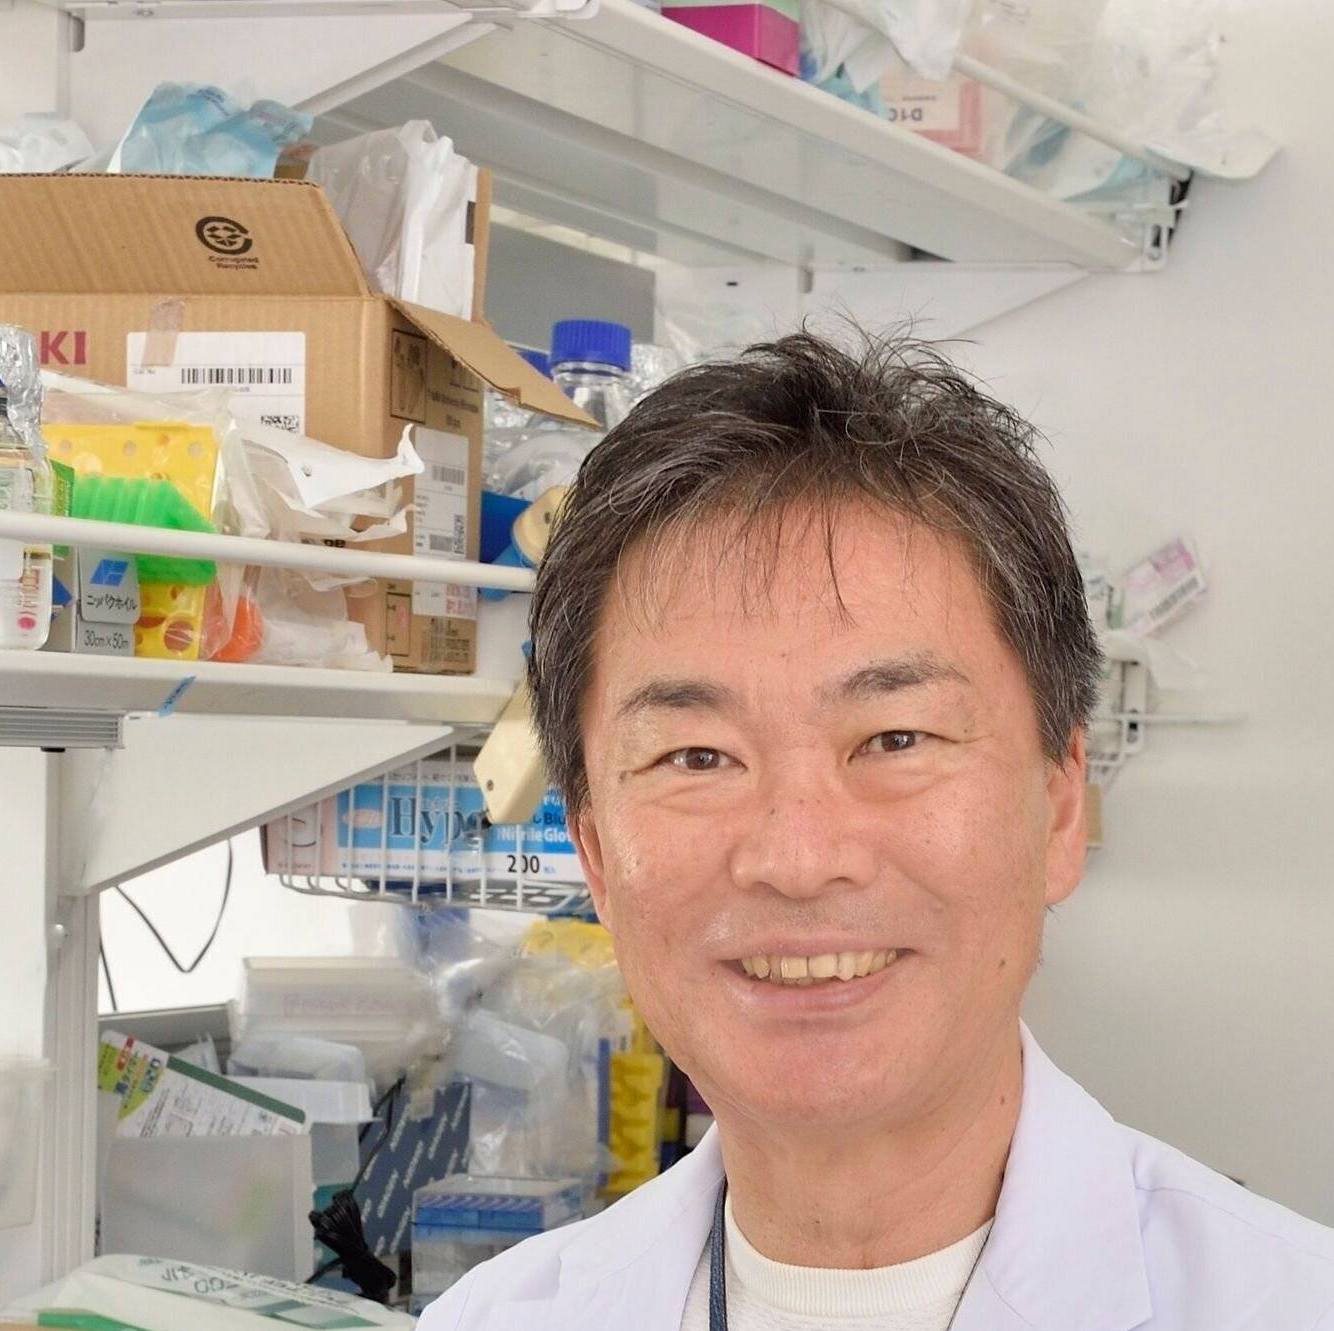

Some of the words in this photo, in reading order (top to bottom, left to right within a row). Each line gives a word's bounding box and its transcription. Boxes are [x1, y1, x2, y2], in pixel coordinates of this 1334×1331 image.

[86, 594, 138, 611] ニッパクホイル
